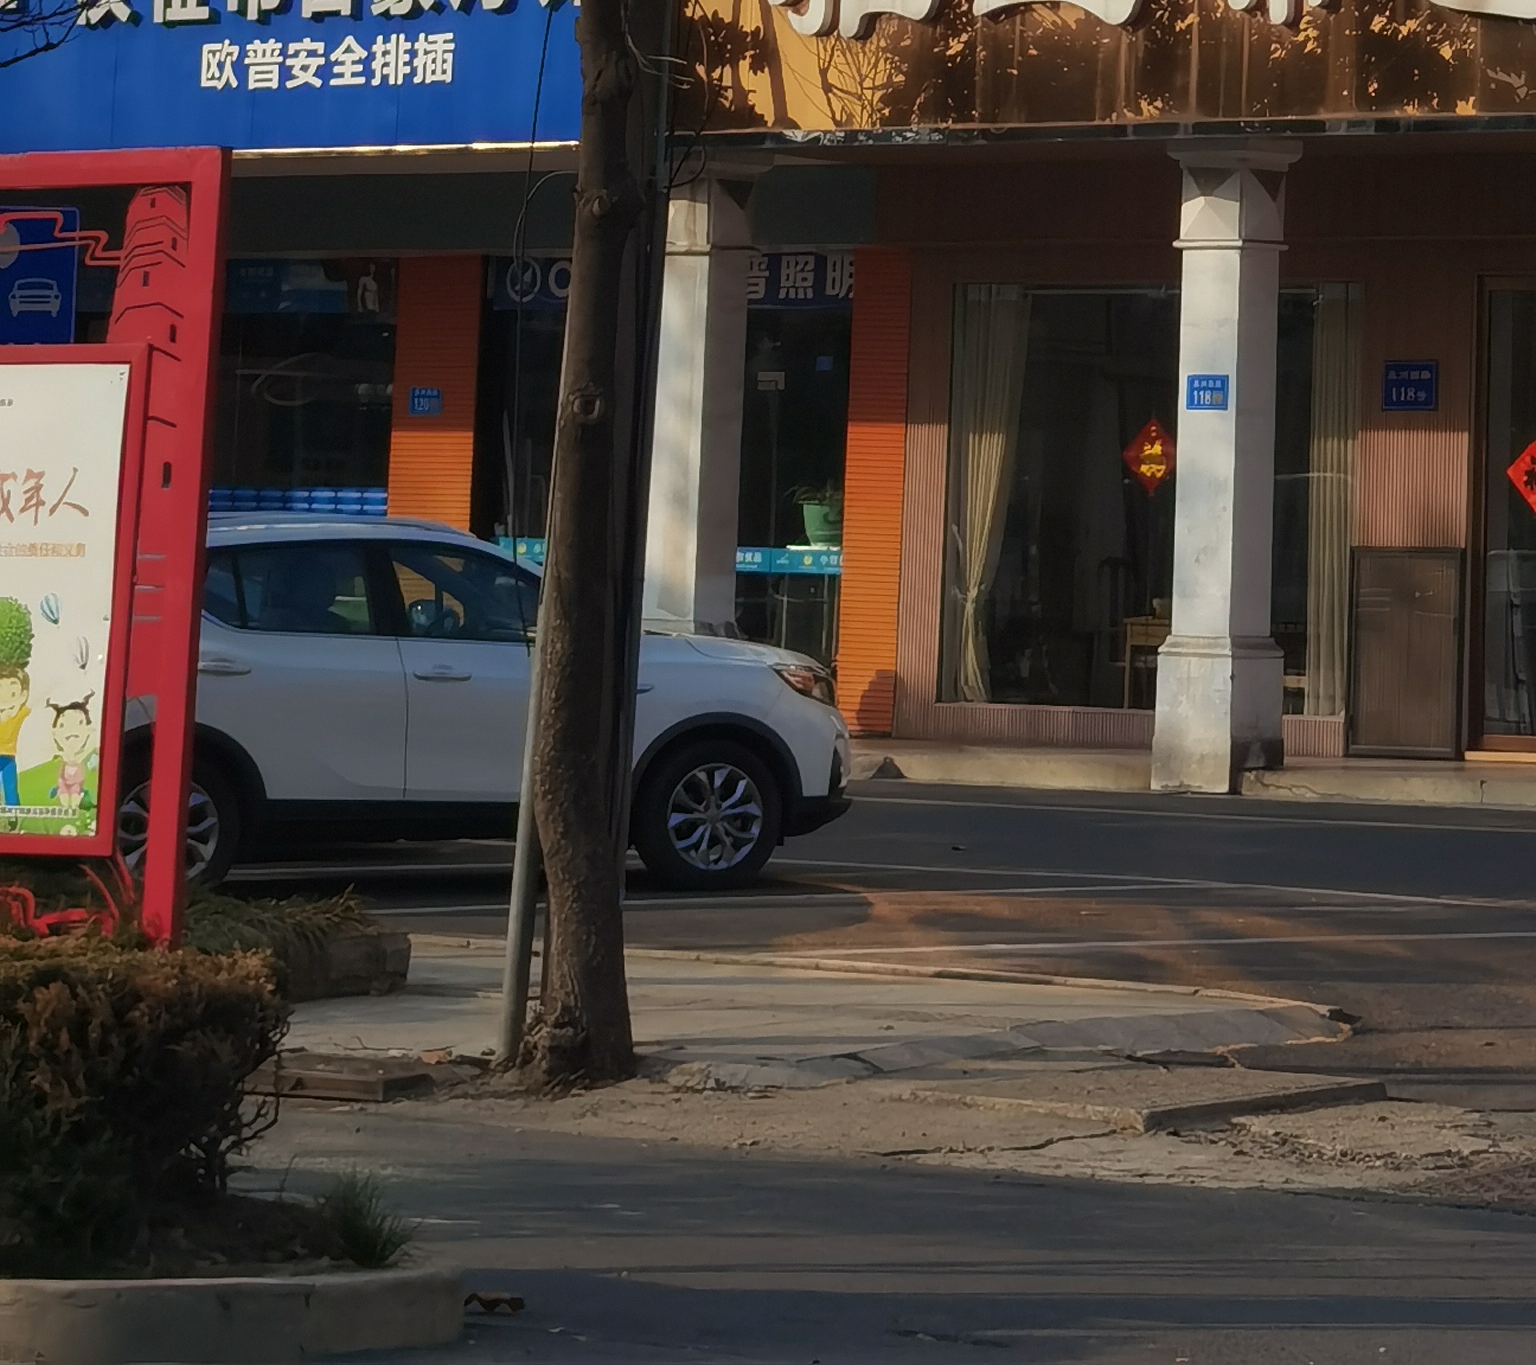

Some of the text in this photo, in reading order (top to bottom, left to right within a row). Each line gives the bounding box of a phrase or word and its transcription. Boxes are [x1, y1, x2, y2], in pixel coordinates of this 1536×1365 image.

[200, 32, 455, 91] 欧普安全排插
[1193, 390, 1212, 405] 118
